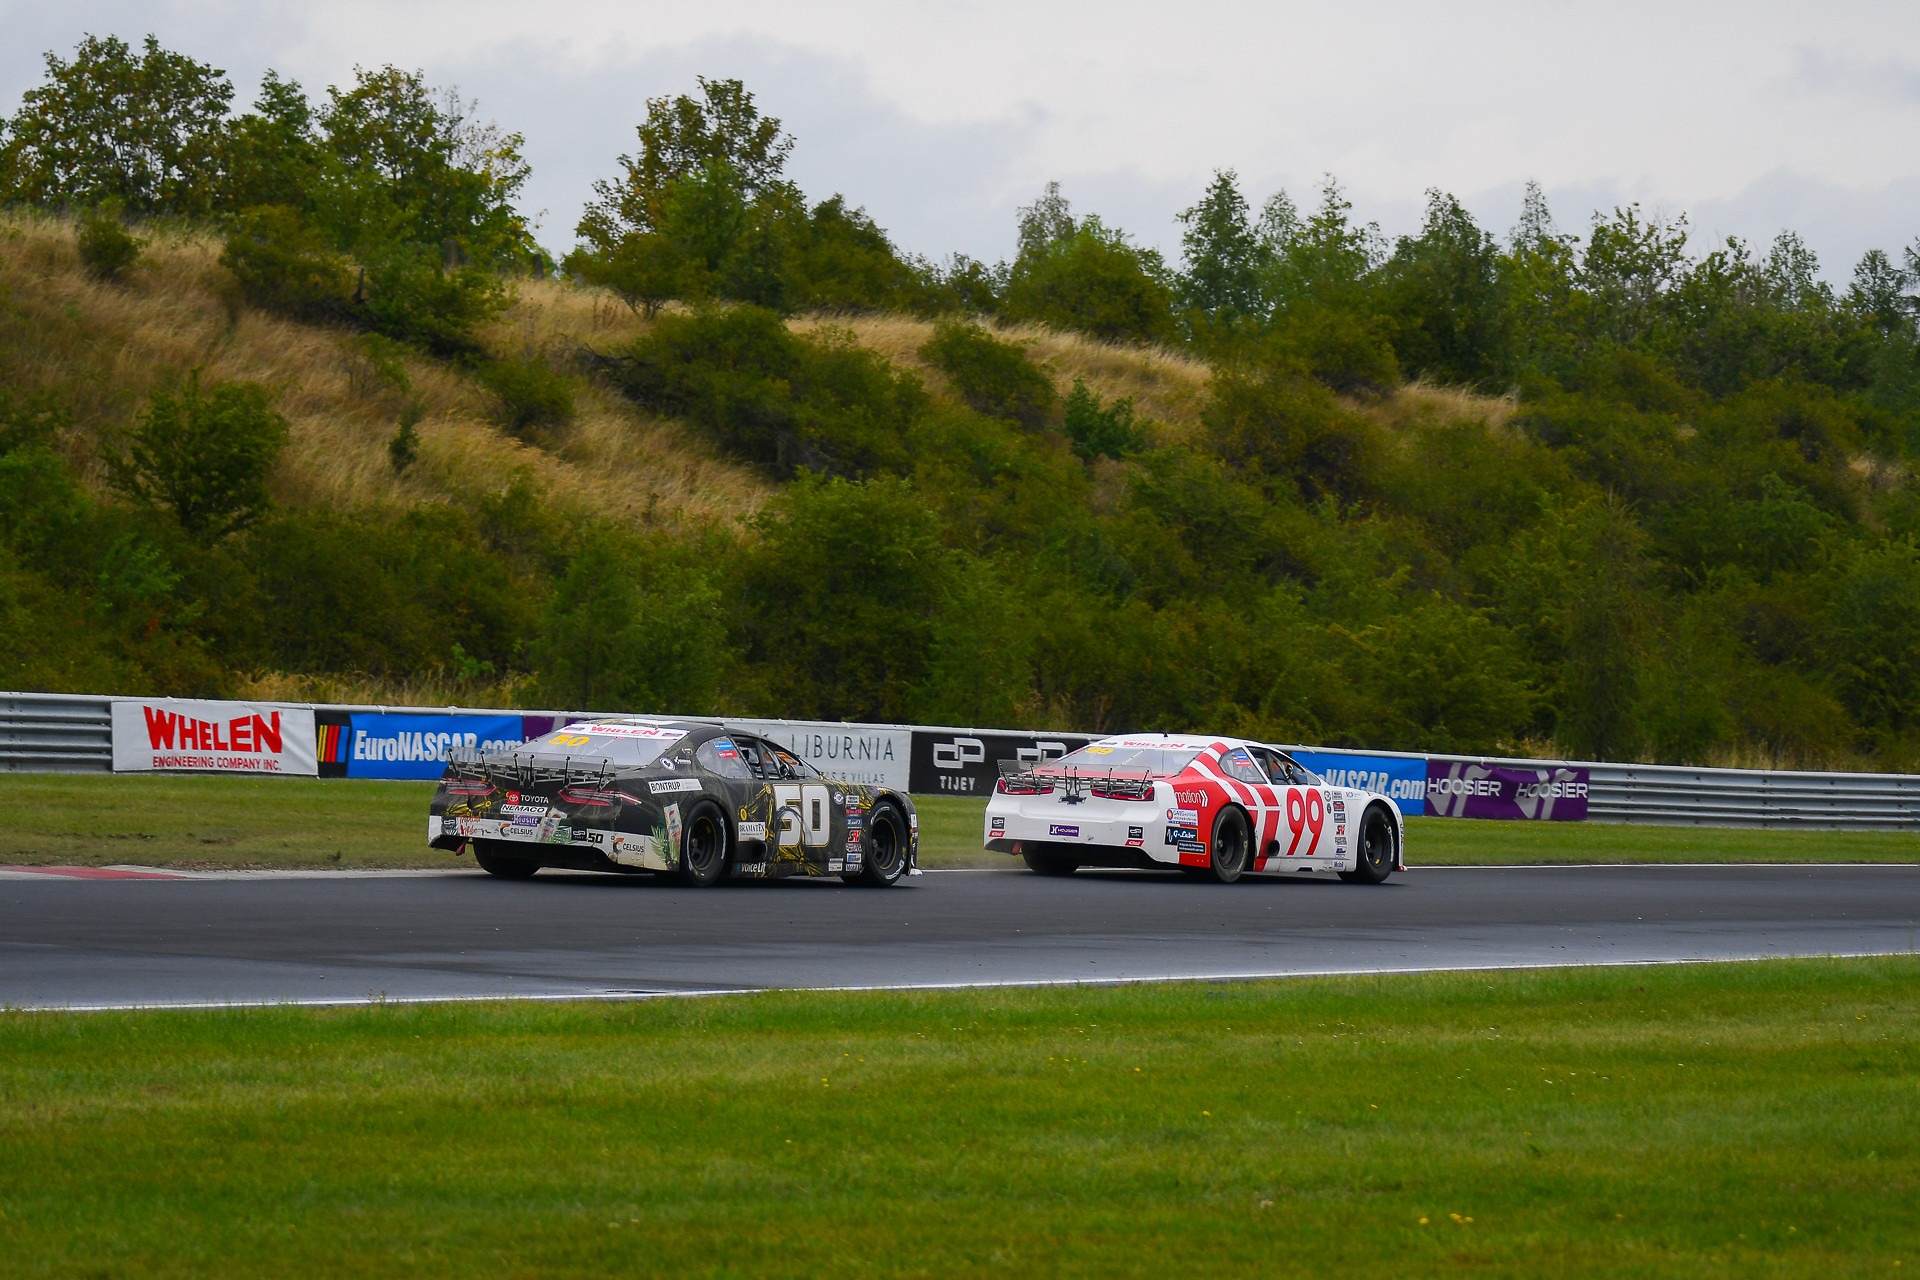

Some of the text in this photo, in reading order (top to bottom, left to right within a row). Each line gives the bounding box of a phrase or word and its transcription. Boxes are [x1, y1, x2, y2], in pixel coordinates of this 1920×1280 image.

[143, 706, 282, 753] WHELEN
[592, 726, 660, 736] WHELEN
[548, 735, 590, 746] 50
[152, 756, 282, 771] ENGINEERING COMPANY INC.
[650, 782, 681, 791] BONTRUP
[940, 775, 976, 791] TIJEY
[1427, 777, 1501, 797] HOOSIER
[1518, 782, 1588, 799] HOOSIER
[520, 794, 549, 804] TOYOTA
[502, 804, 545, 813] NEMACO
[773, 784, 830, 847] 50
[1286, 787, 1325, 856] 99
[510, 828, 533, 836] CELSIUS
[587, 833, 604, 843] 50
[622, 842, 645, 853] CELSIUS
